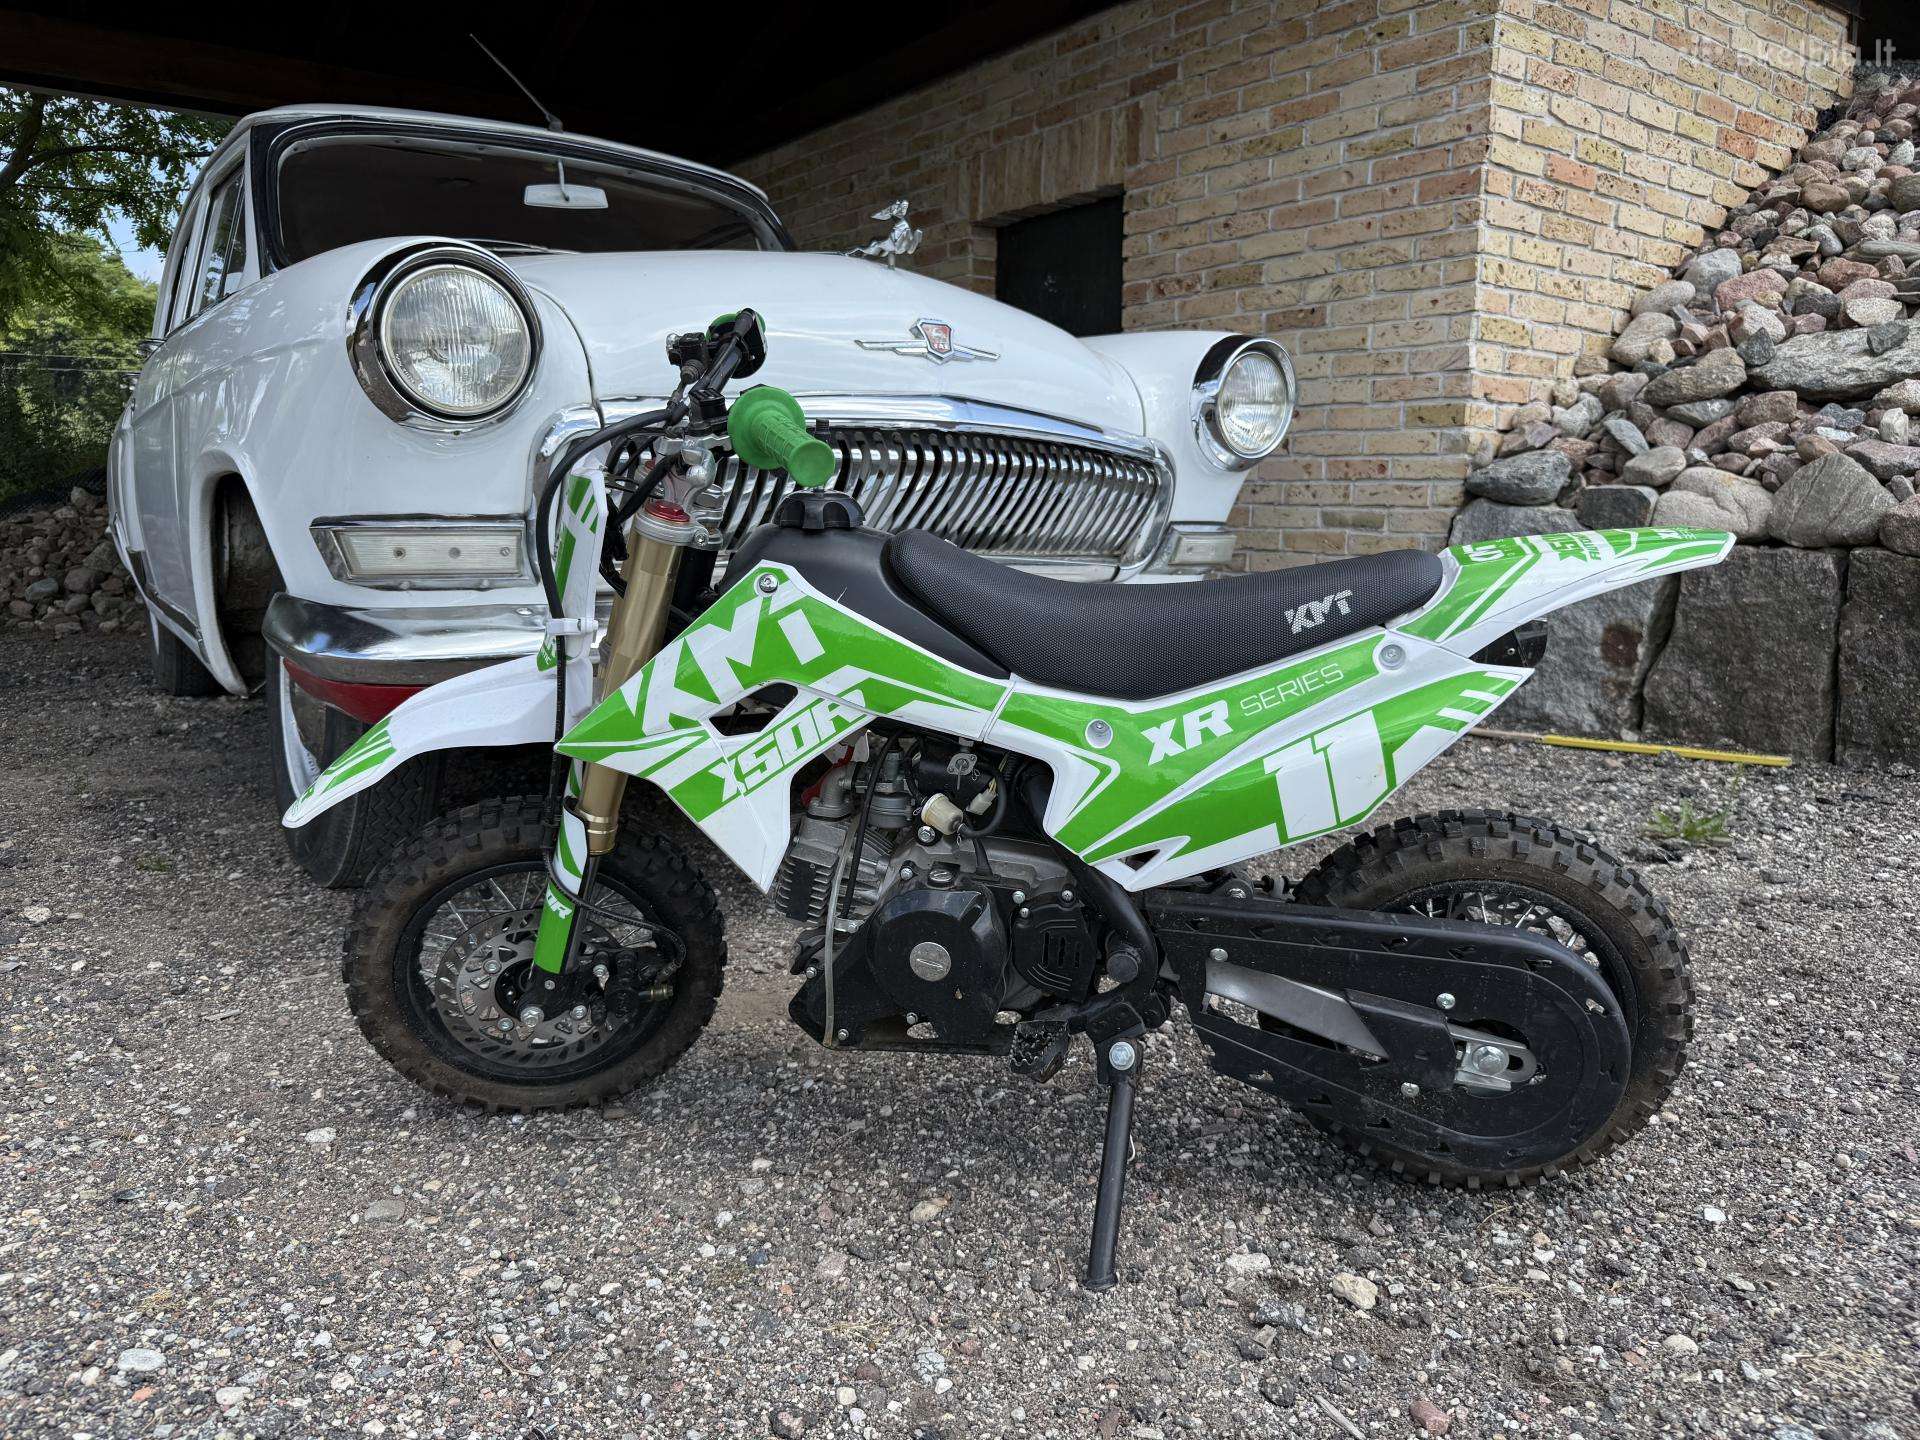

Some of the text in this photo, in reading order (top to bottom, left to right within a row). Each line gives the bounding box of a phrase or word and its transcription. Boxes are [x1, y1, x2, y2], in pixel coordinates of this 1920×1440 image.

[620, 580, 826, 735] KMT
[1284, 590, 1353, 634] KMT
[1140, 663, 1344, 766] XR SERIES
